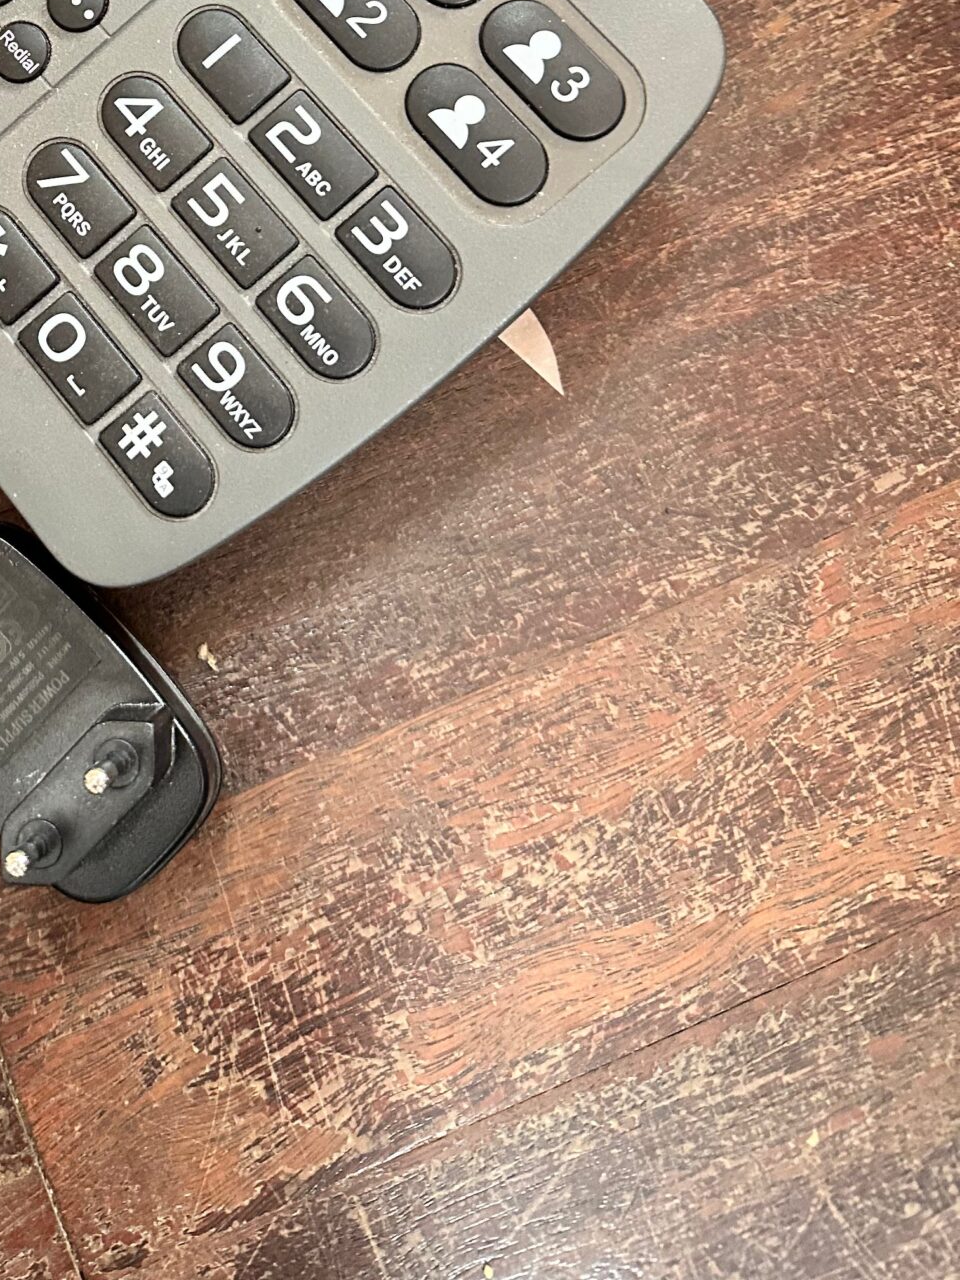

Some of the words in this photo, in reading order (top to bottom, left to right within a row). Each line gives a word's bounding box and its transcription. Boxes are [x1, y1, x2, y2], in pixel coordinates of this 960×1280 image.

[345, 0, 388, 39] 2
[201, 33, 243, 70] 1
[550, 65, 591, 103] 3
[113, 96, 165, 138] 4
[139, 137, 171, 171] GHI
[264, 104, 322, 164] 2
[294, 162, 332, 197] ABC
[476, 139, 516, 169] 4
[36, 148, 91, 189] 7
[52, 192, 92, 237] PQRS
[186, 172, 246, 228] 5
[216, 228, 249, 267] JKL
[350, 199, 409, 255] 3
[382, 255, 423, 291] DEF
[113, 243, 165, 296] 8
[140, 294, 176, 332] TUV
[276, 274, 333, 326] 6
[299, 324, 339, 366] MNO
[190, 341, 246, 392] 9
[219, 390, 263, 439] WXYZ
[117, 411, 166, 460] #
[25, 668, 72, 716] POWER
